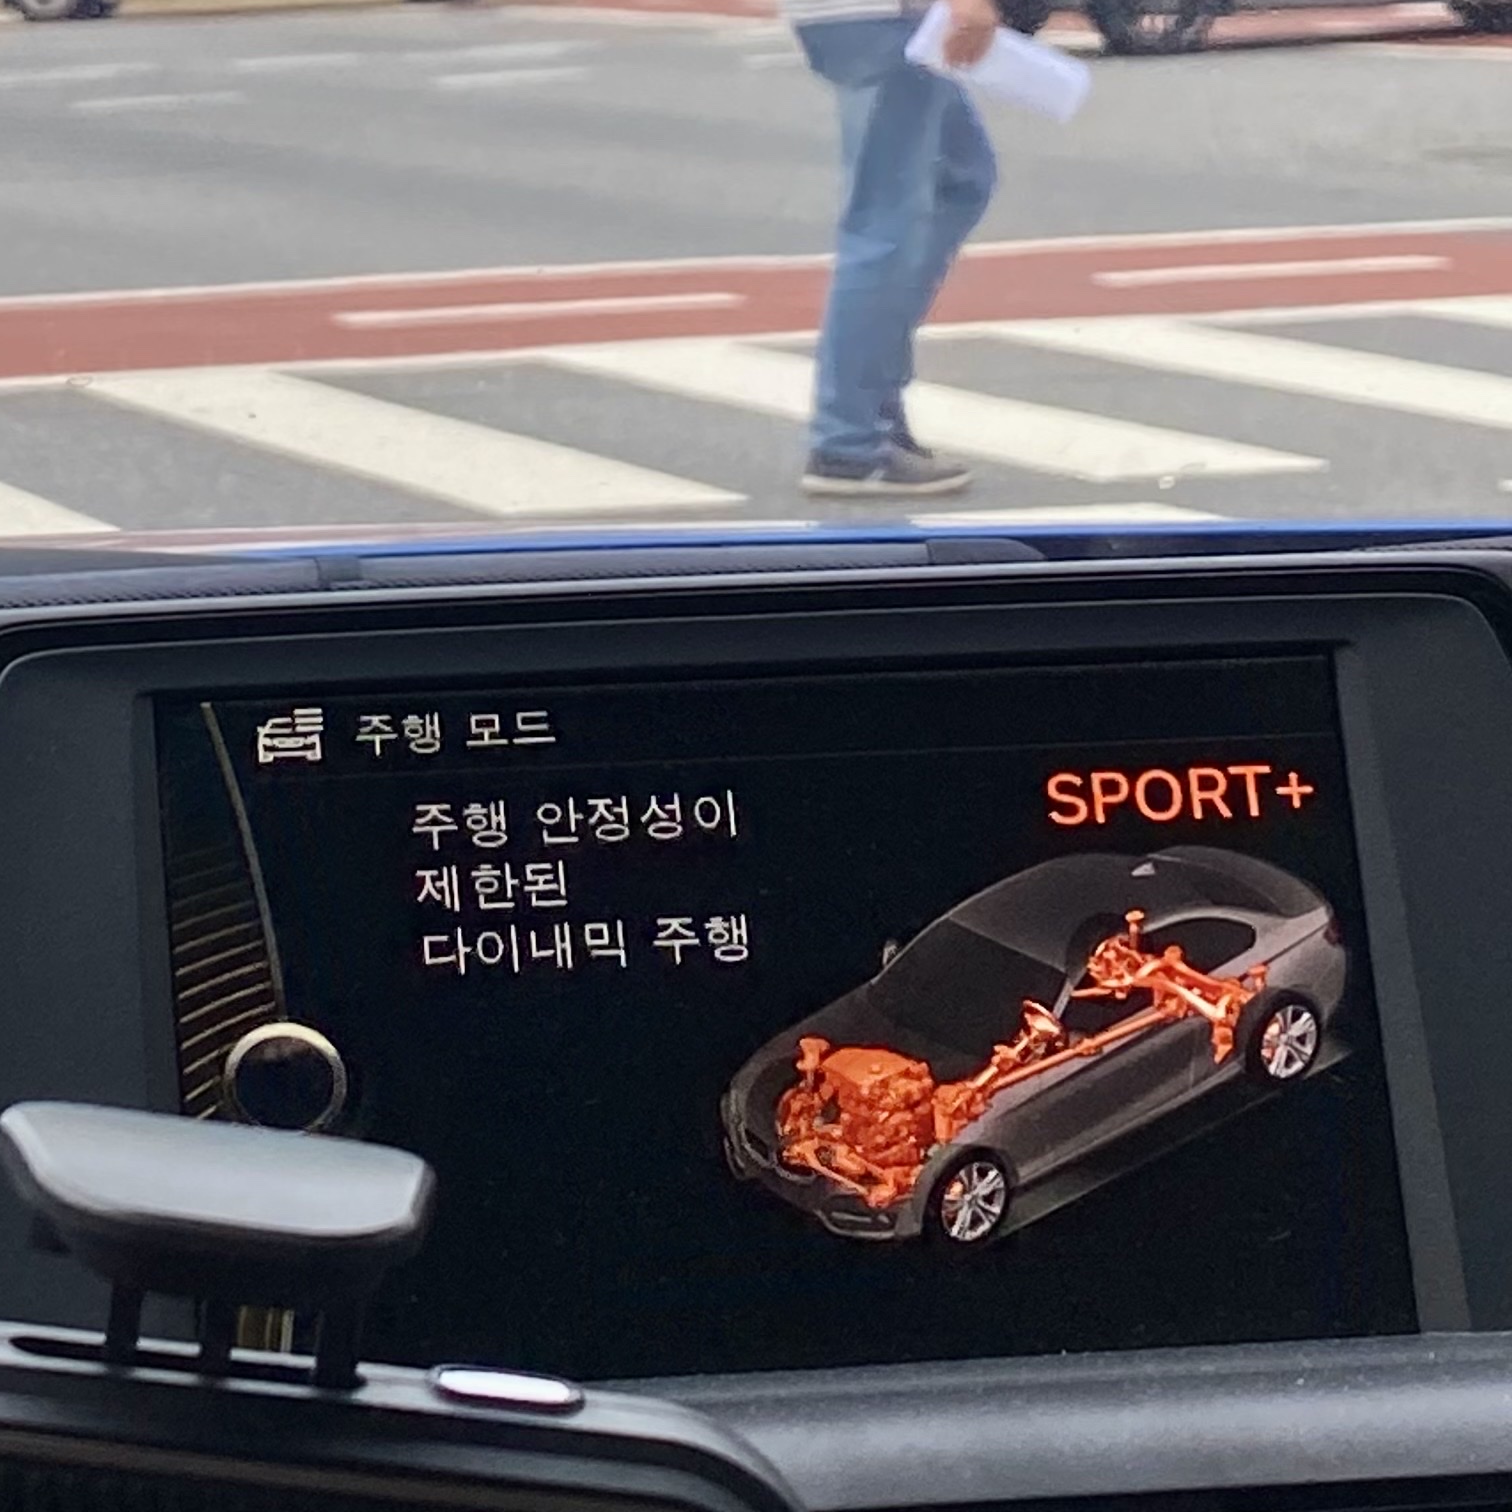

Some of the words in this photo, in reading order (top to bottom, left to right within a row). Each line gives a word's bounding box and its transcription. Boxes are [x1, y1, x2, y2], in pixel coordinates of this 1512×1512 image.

[356, 711, 442, 756] 주행
[466, 710, 557, 748] 모드
[412, 799, 509, 851] 주행
[535, 789, 737, 845] 안정성이
[1046, 764, 1315, 826] SPORT+
[415, 859, 569, 913] 제한된
[423, 918, 628, 976] 다이내믹
[652, 913, 750, 966] 주행
